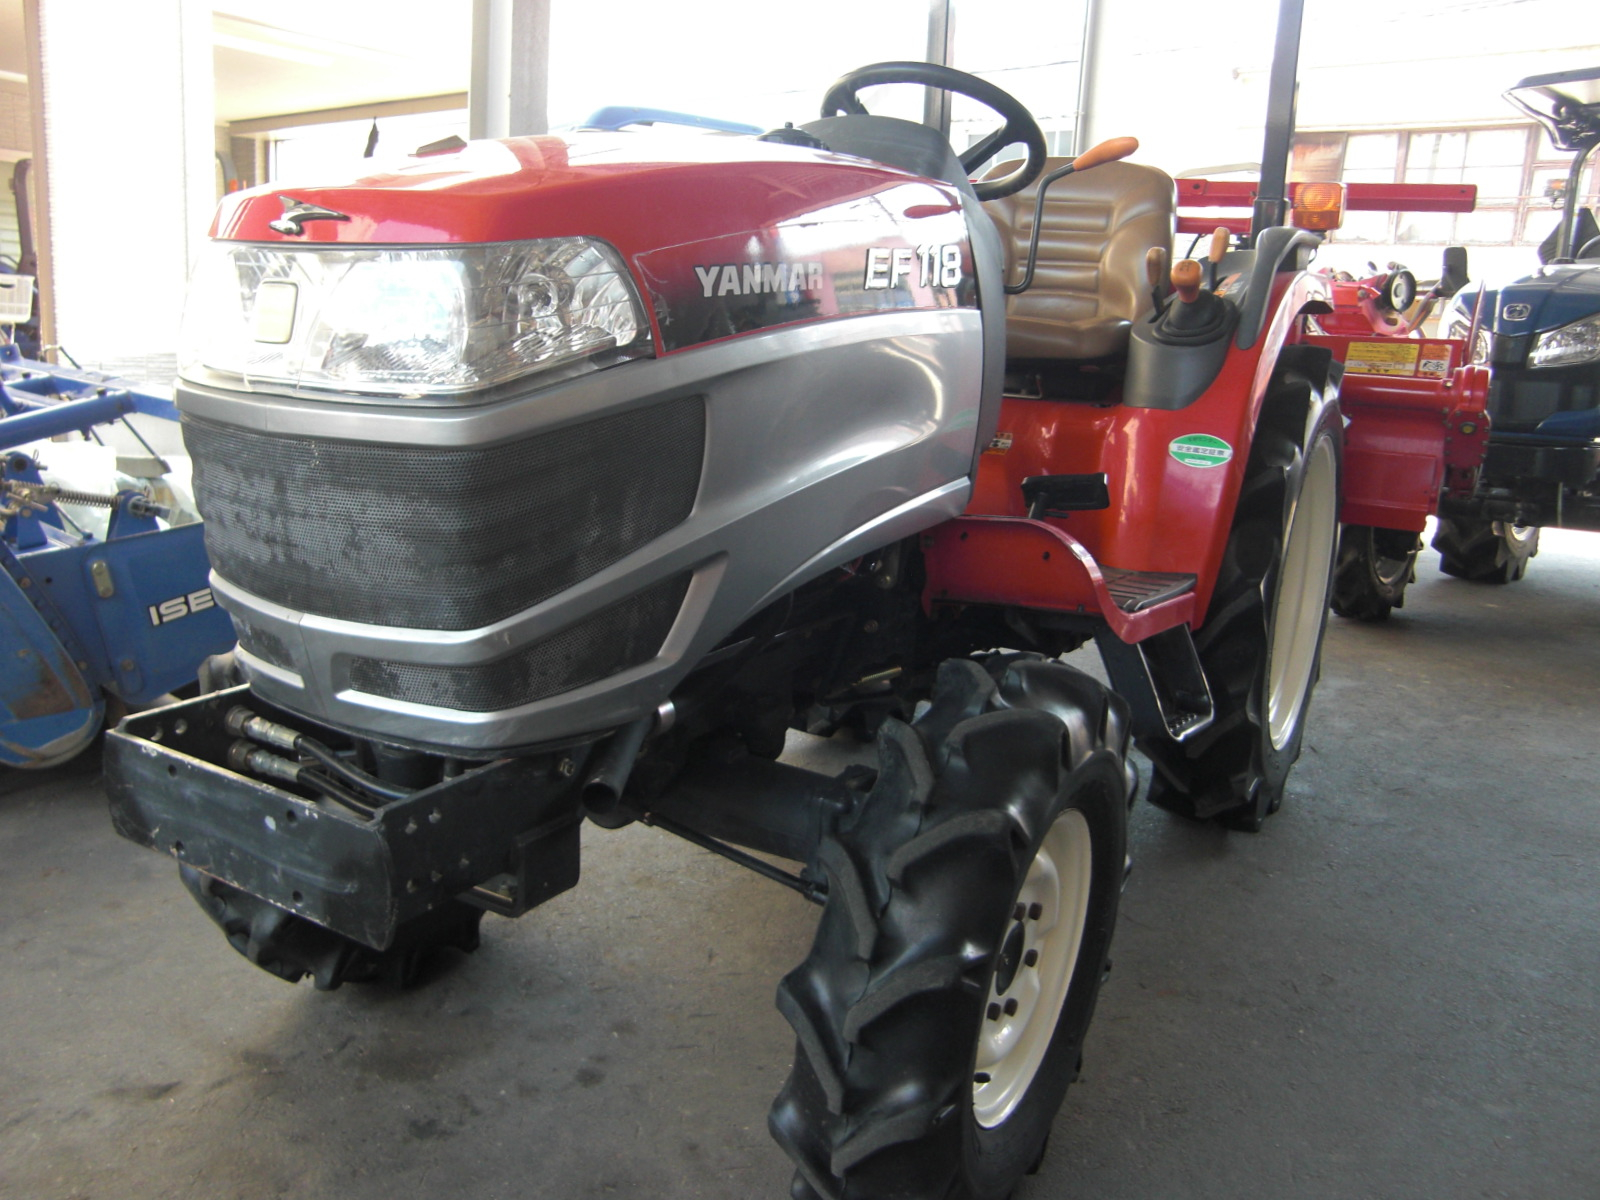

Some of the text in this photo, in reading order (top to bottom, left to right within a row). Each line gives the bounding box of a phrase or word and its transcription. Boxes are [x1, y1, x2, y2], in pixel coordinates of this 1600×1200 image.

[695, 262, 823, 298] YANMAR
[864, 243, 963, 290] EF118
[149, 588, 215, 626] ISE
